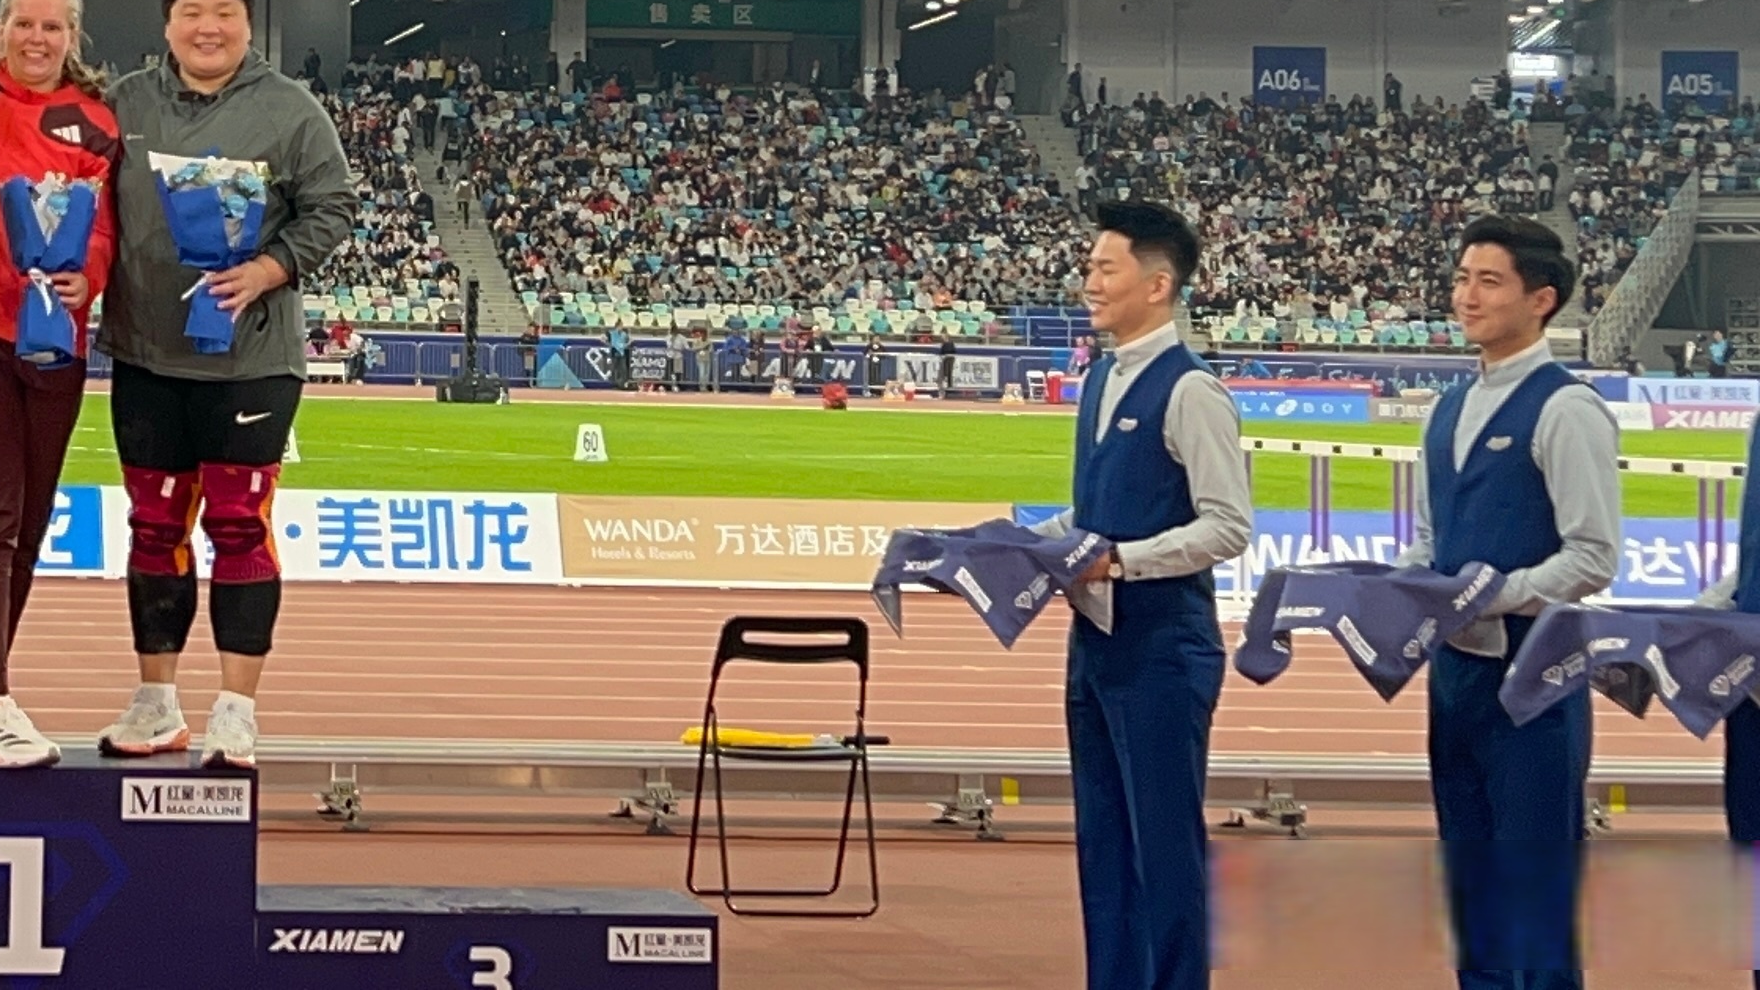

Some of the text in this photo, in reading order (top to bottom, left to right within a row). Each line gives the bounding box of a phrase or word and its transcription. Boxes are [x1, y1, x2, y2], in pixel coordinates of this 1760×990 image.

[1257, 68, 1302, 91] A06
[1666, 73, 1713, 96] A05
[583, 430, 599, 453] 60
[584, 518, 695, 543] WANDA
[714, 523, 888, 557] 万达酒店及
[648, 547, 696, 561] Resorts
[130, 784, 164, 815] M
[166, 805, 244, 817] MACALLINE
[269, 929, 405, 953] XIAMEN
[615, 932, 641, 958] M
[644, 949, 707, 959] MACALLINE
[468, 946, 513, 990] 3
